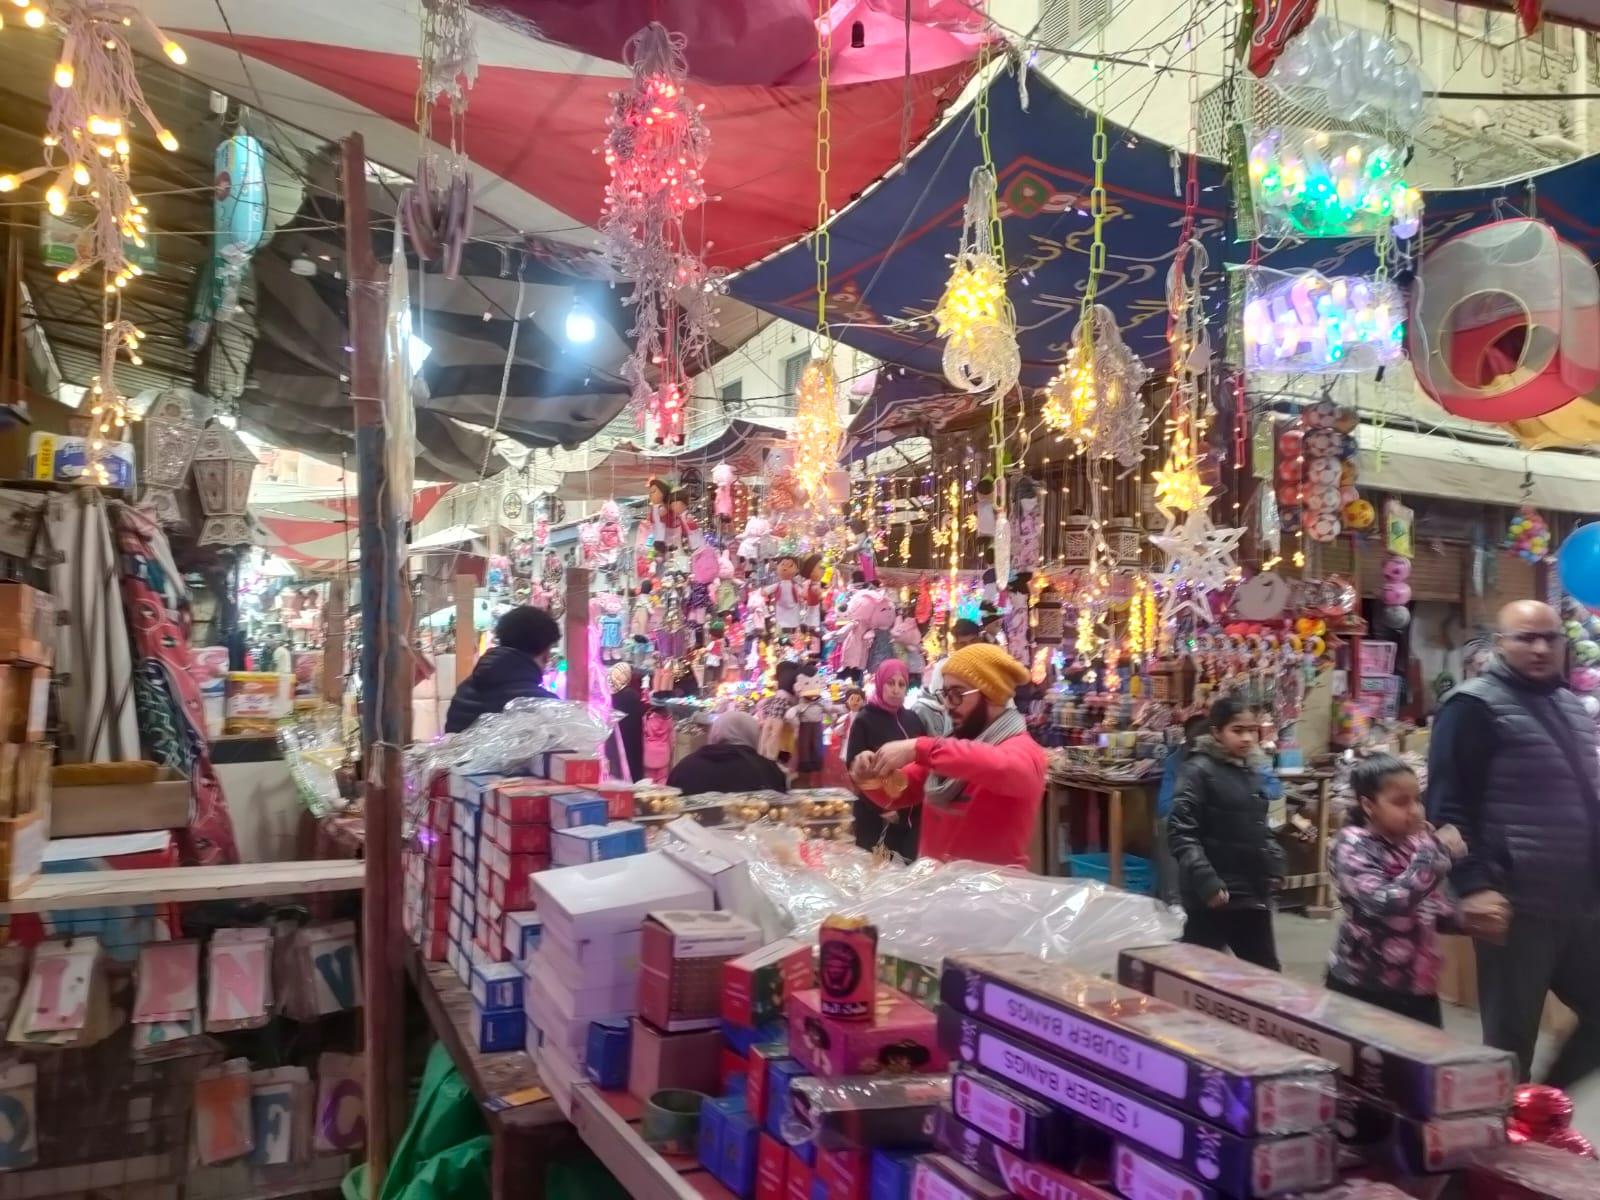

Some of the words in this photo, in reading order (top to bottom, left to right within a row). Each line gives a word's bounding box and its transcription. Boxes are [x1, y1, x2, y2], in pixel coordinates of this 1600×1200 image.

[32, 958, 86, 1029] L
[211, 951, 266, 1020] N
[315, 945, 354, 1010] V
[1007, 998, 1064, 1036] BANGS
[1068, 1022, 1130, 1065] SUBER
[1194, 993, 1250, 1031] SUBER
[1255, 1017, 1321, 1056] BANGS
[1002, 1050, 1060, 1092] BANGS
[1065, 1077, 1128, 1124] SUBER
[250, 1091, 289, 1165] F
